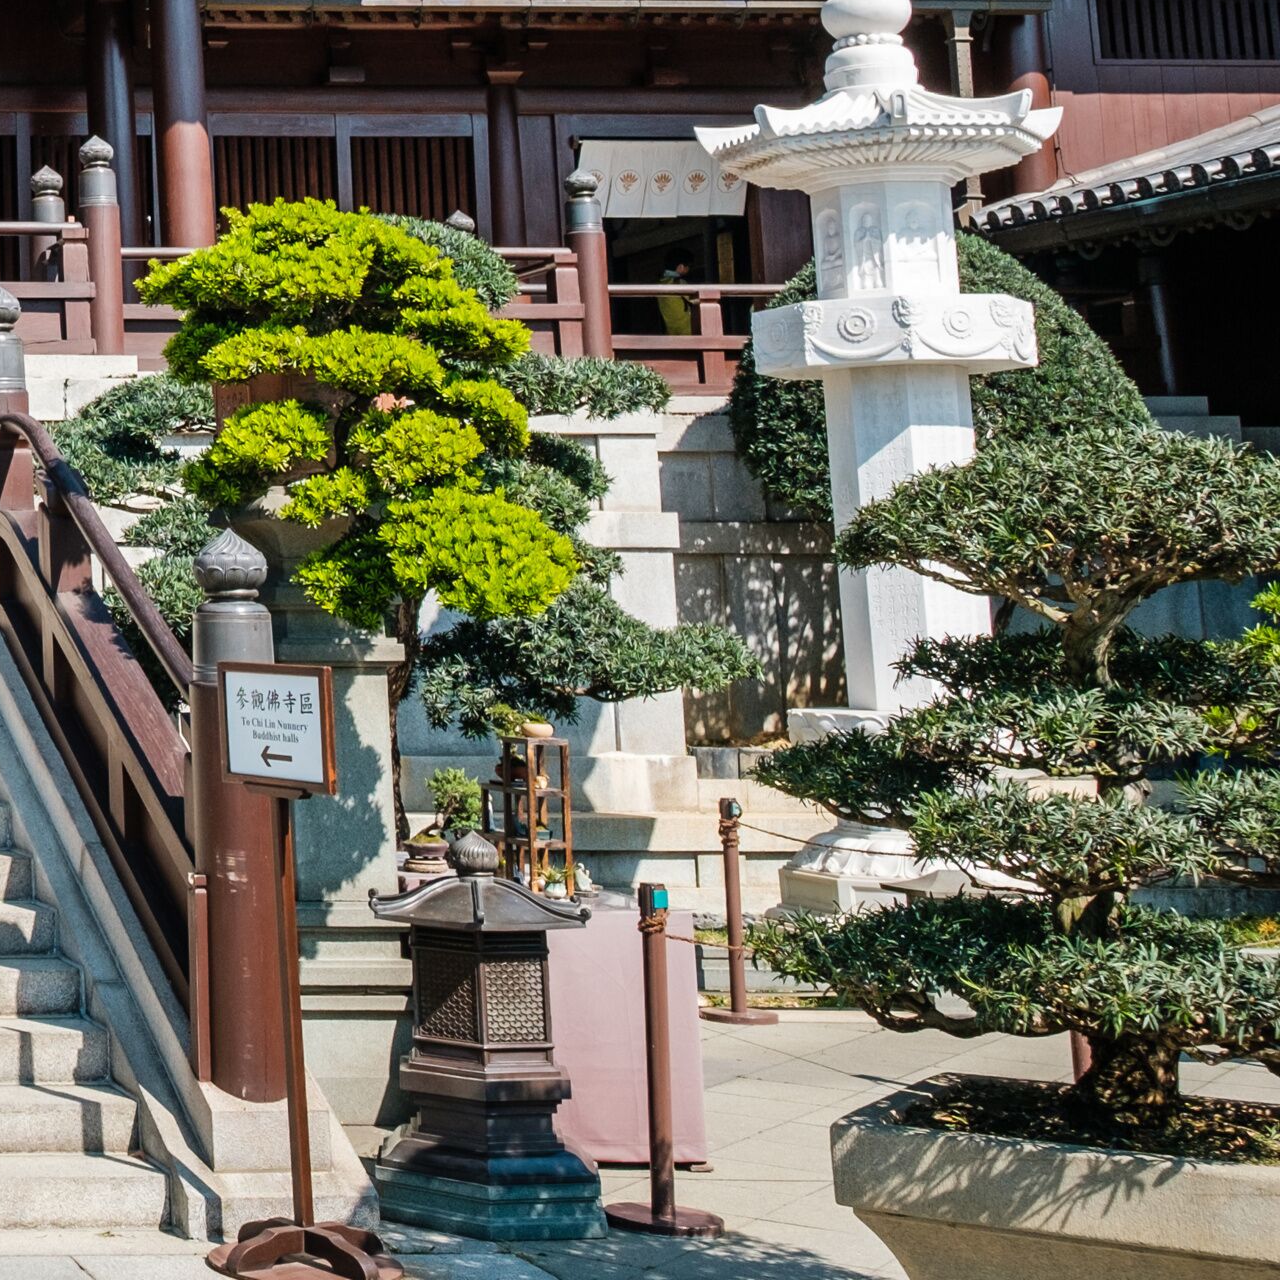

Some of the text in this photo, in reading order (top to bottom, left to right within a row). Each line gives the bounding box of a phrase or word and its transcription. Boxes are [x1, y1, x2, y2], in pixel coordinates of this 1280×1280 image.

[241, 717, 308, 733] To Chi Lin Nunnery
[252, 730, 299, 743] Buddhist halls
